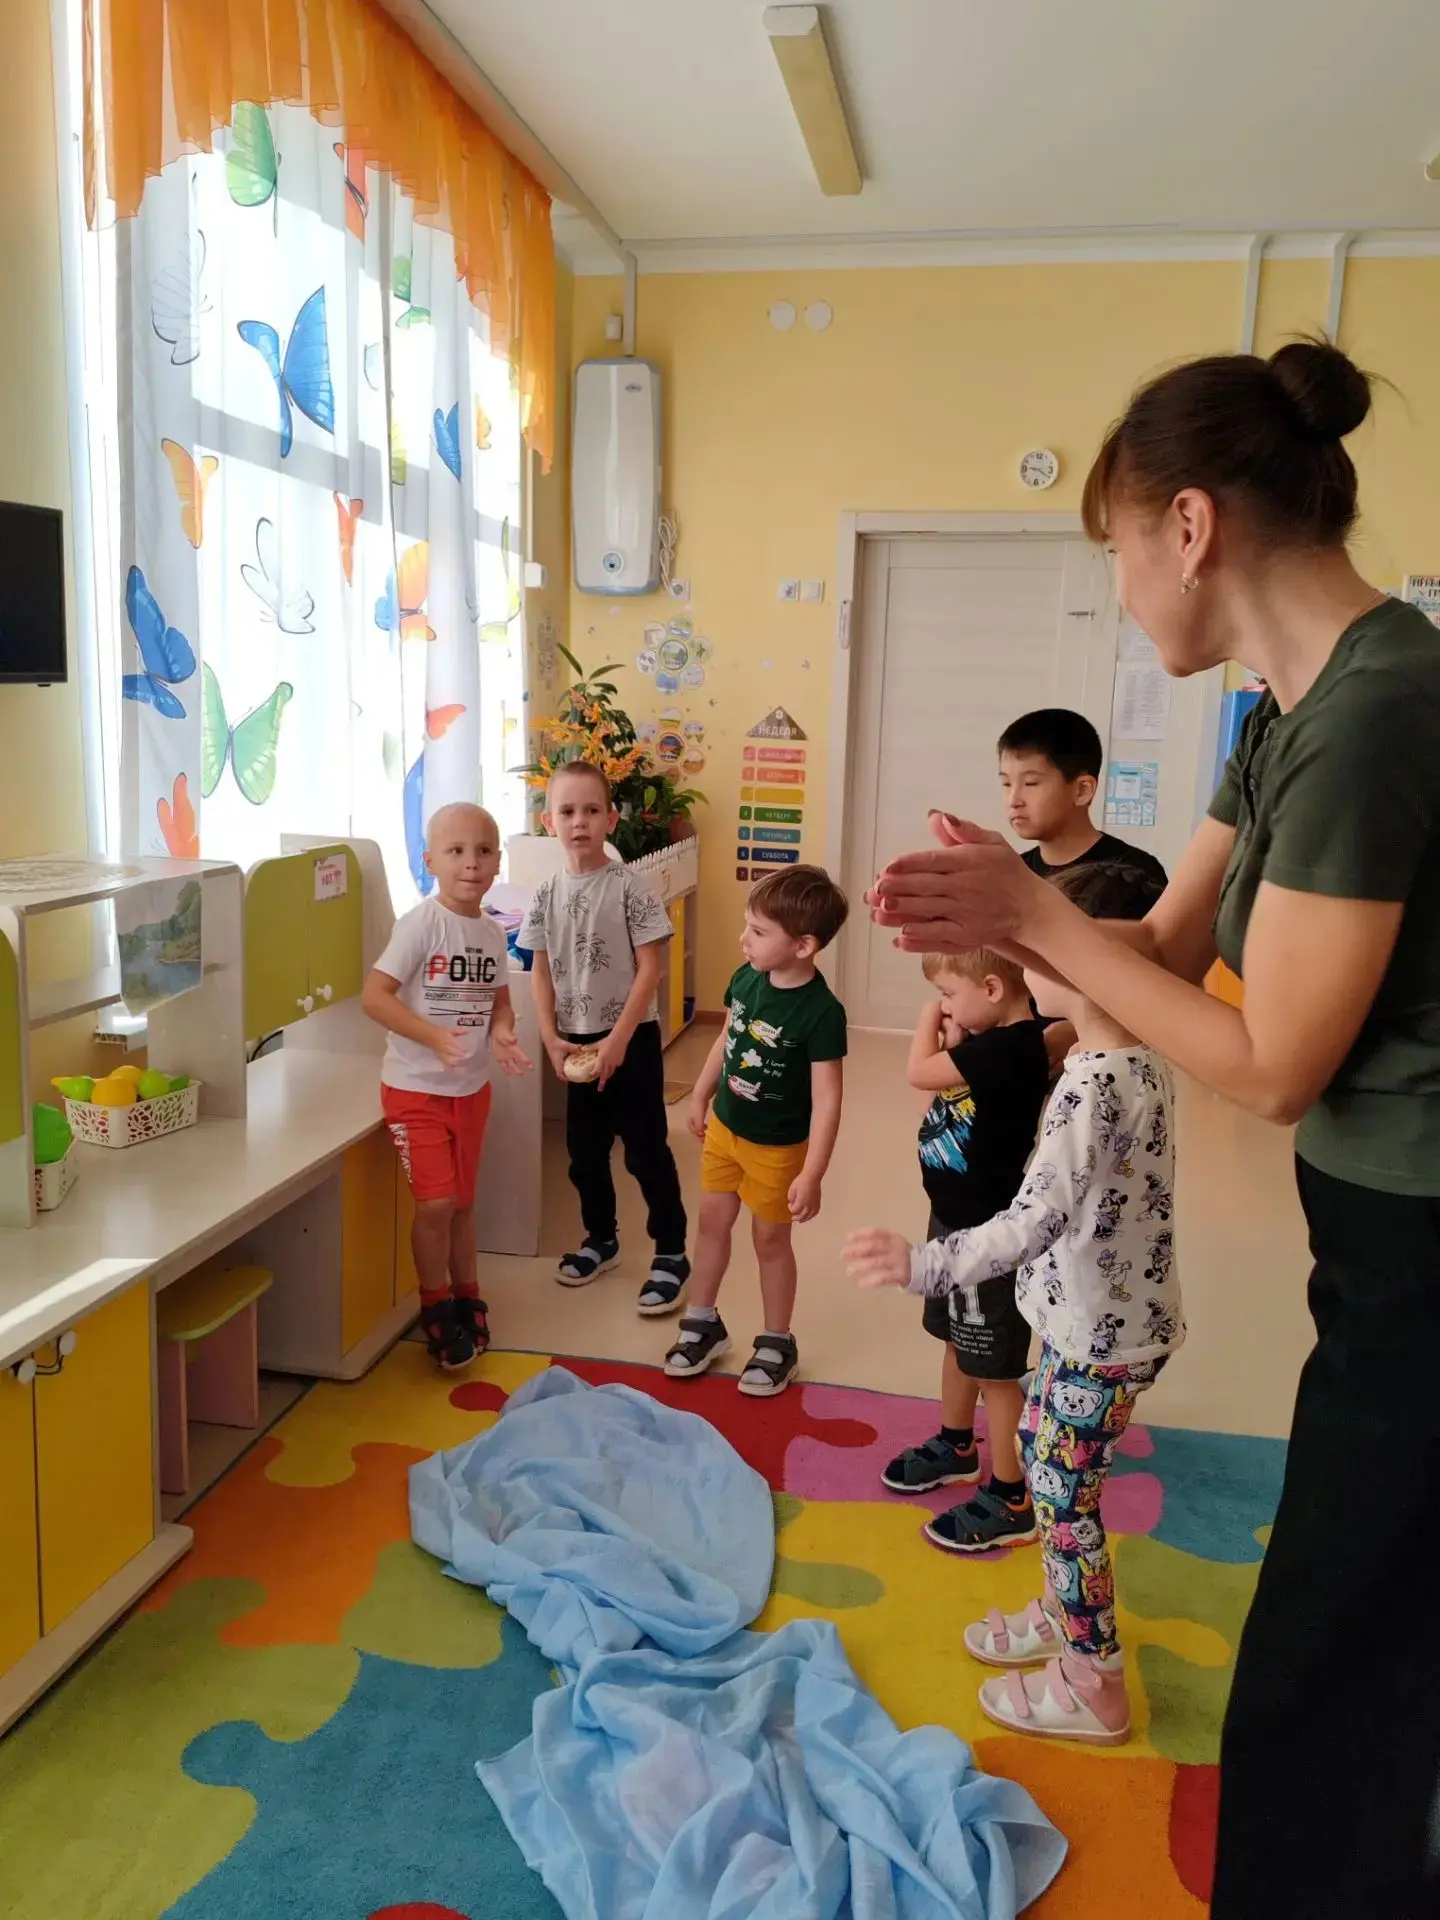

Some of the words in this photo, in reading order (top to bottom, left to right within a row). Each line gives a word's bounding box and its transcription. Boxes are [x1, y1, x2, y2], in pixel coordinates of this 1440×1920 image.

[759, 726, 797, 738] НЕДЕЛЯ
[761, 850, 789, 860] СУББОТА
[428, 953, 499, 984] POLIC
